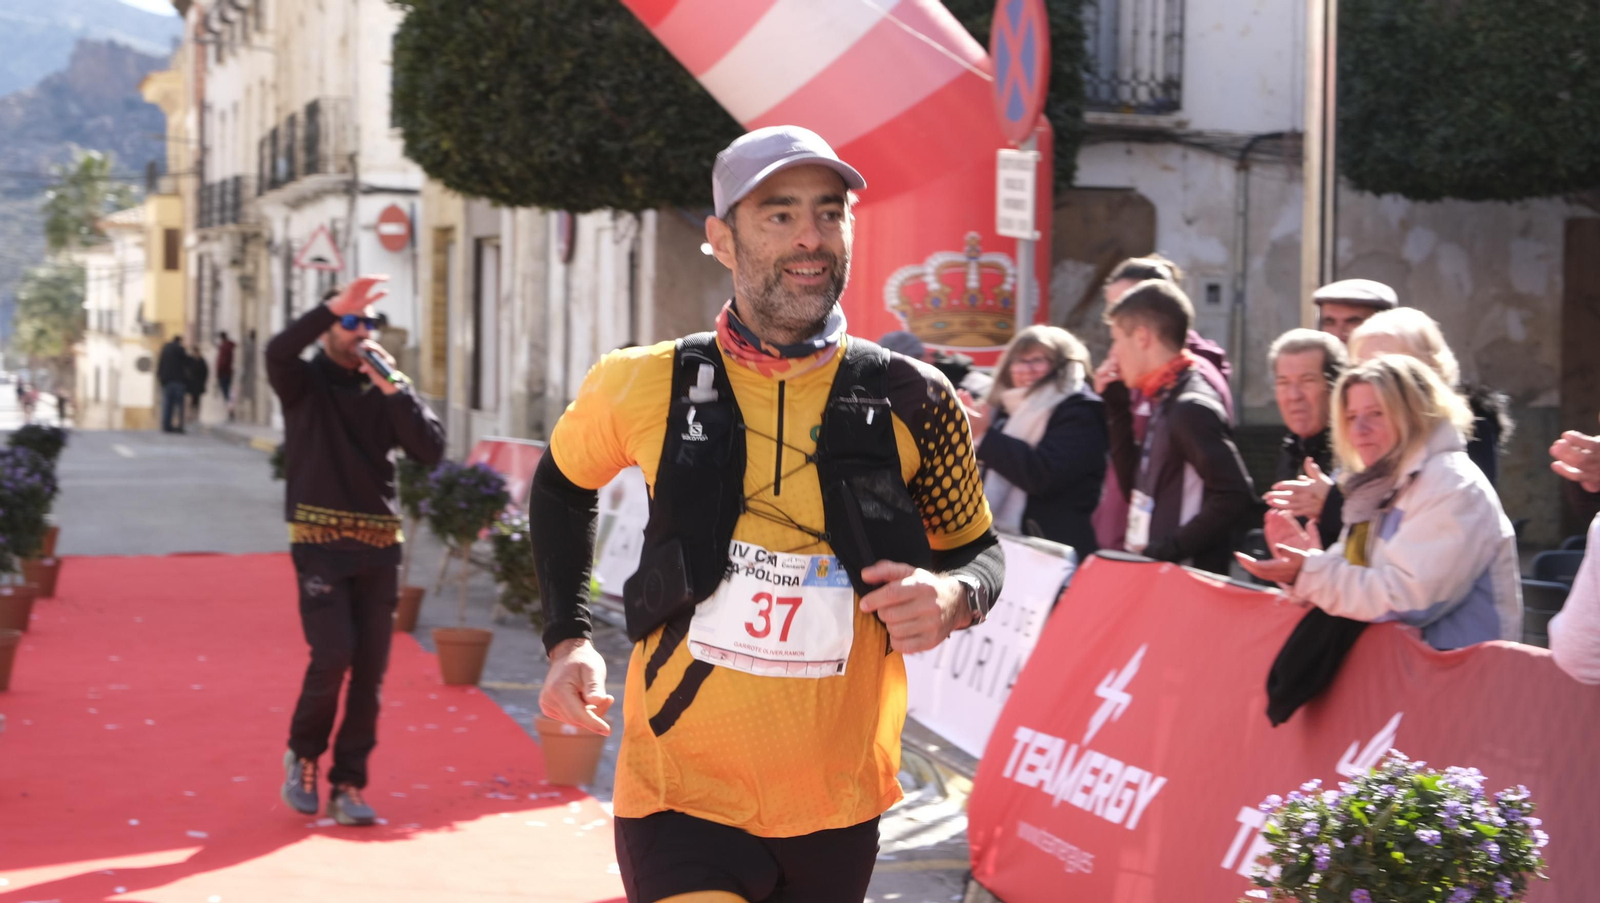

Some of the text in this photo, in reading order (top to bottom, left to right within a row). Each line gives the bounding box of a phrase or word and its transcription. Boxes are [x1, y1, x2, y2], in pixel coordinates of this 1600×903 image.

[732, 542, 750, 559] IV
[744, 592, 803, 642] 37
[733, 641, 762, 653] GARROTE
